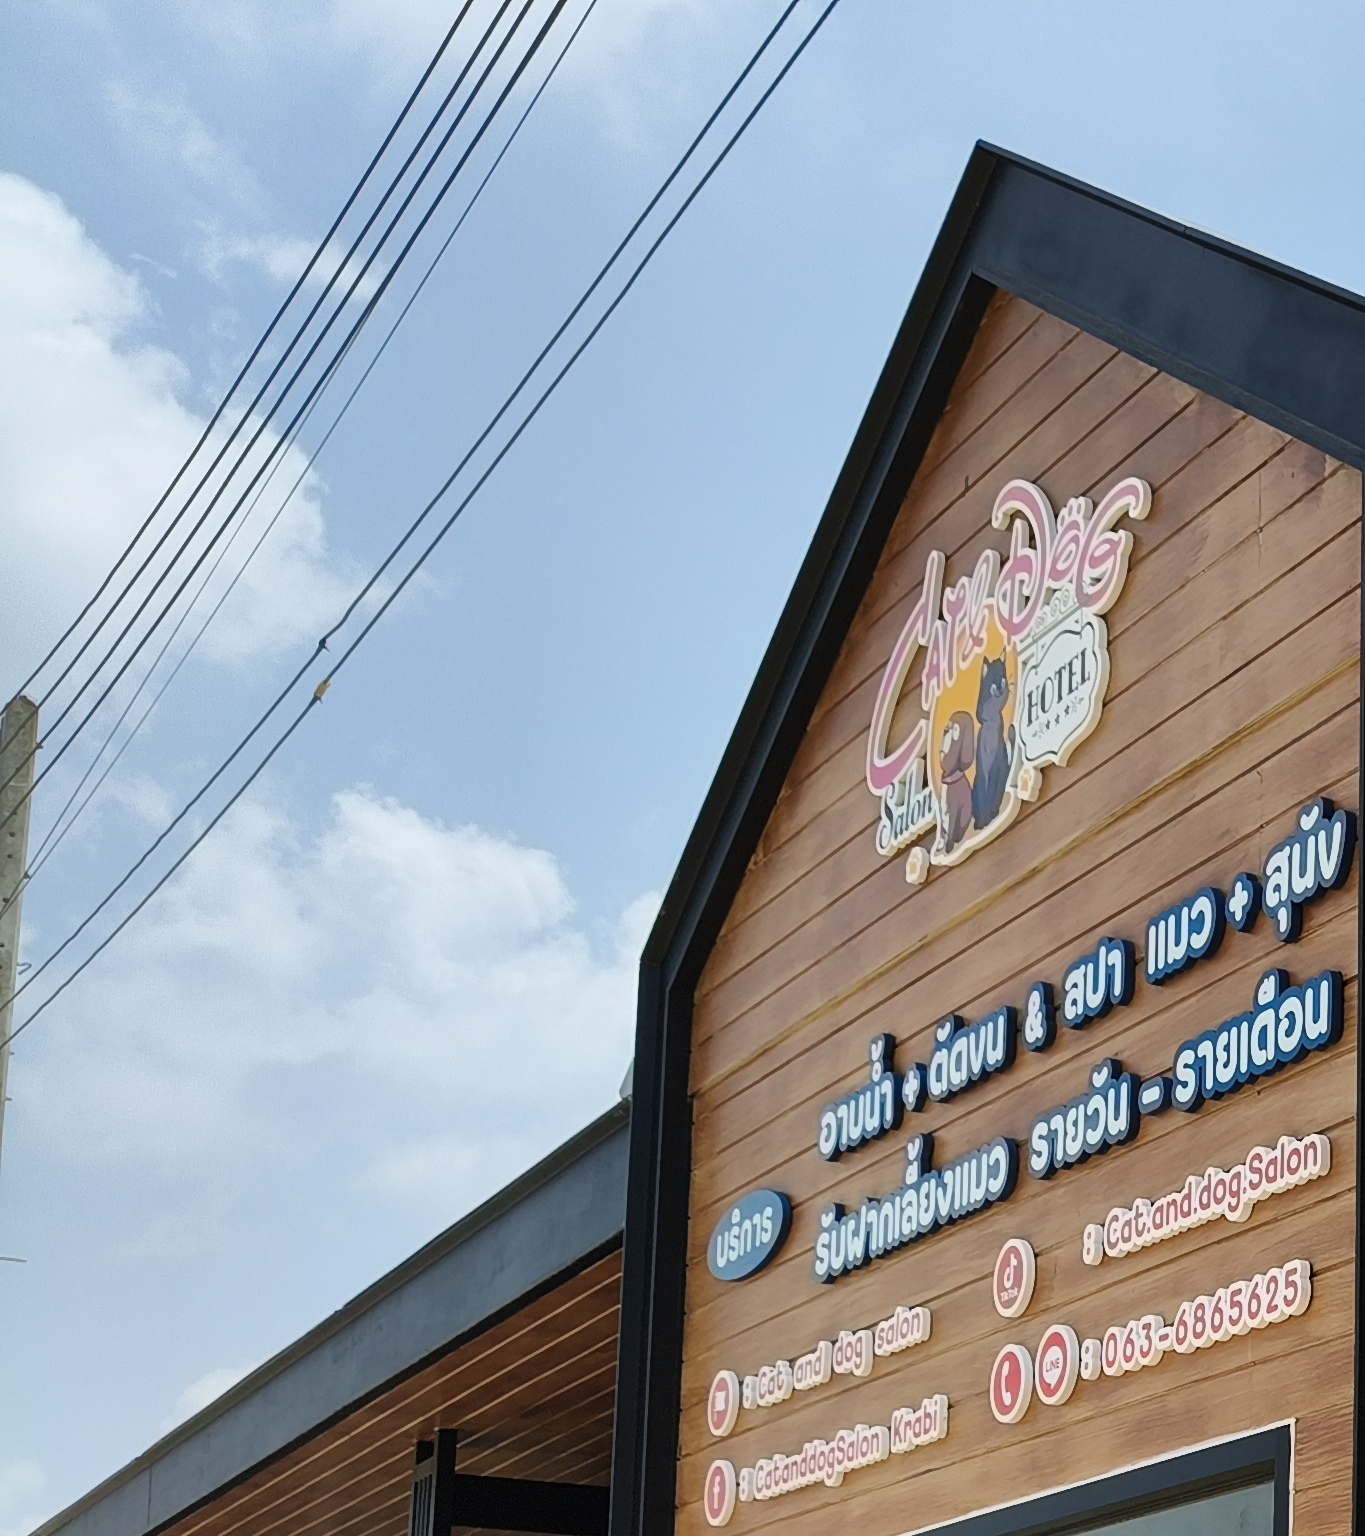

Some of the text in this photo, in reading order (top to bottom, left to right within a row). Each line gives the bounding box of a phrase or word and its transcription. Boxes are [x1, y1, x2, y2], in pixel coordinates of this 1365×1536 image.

[1027, 649, 1091, 727] HOTEL
[880, 783, 934, 849] Salon
[819, 1039, 893, 1155] อาบน้ำ
[930, 1014, 1005, 1097] ตัดขน
[1064, 945, 1122, 1021] สปา
[1148, 896, 1212, 975] แมว
[1266, 804, 1343, 934] สุนัข
[815, 1136, 1008, 1276] รับฝากเลี้ยงแมว
[1030, 1065, 1129, 1172] รายวัน
[1175, 974, 1330, 1104] รายเดือน
[714, 1205, 773, 1269] บริการ
[1106, 1140, 1318, 1251] Cat.and.dog.Salon
[758, 1369, 786, 1401] Cat
[795, 1346, 823, 1385] and
[834, 1334, 864, 1371] dog
[877, 1311, 922, 1350] salon
[1105, 1266, 1299, 1370] 063-6865625
[1045, 1356, 1061, 1374] LINE
[756, 1429, 880, 1495] CatanddogSalon
[892, 1399, 939, 1449] Krabi
